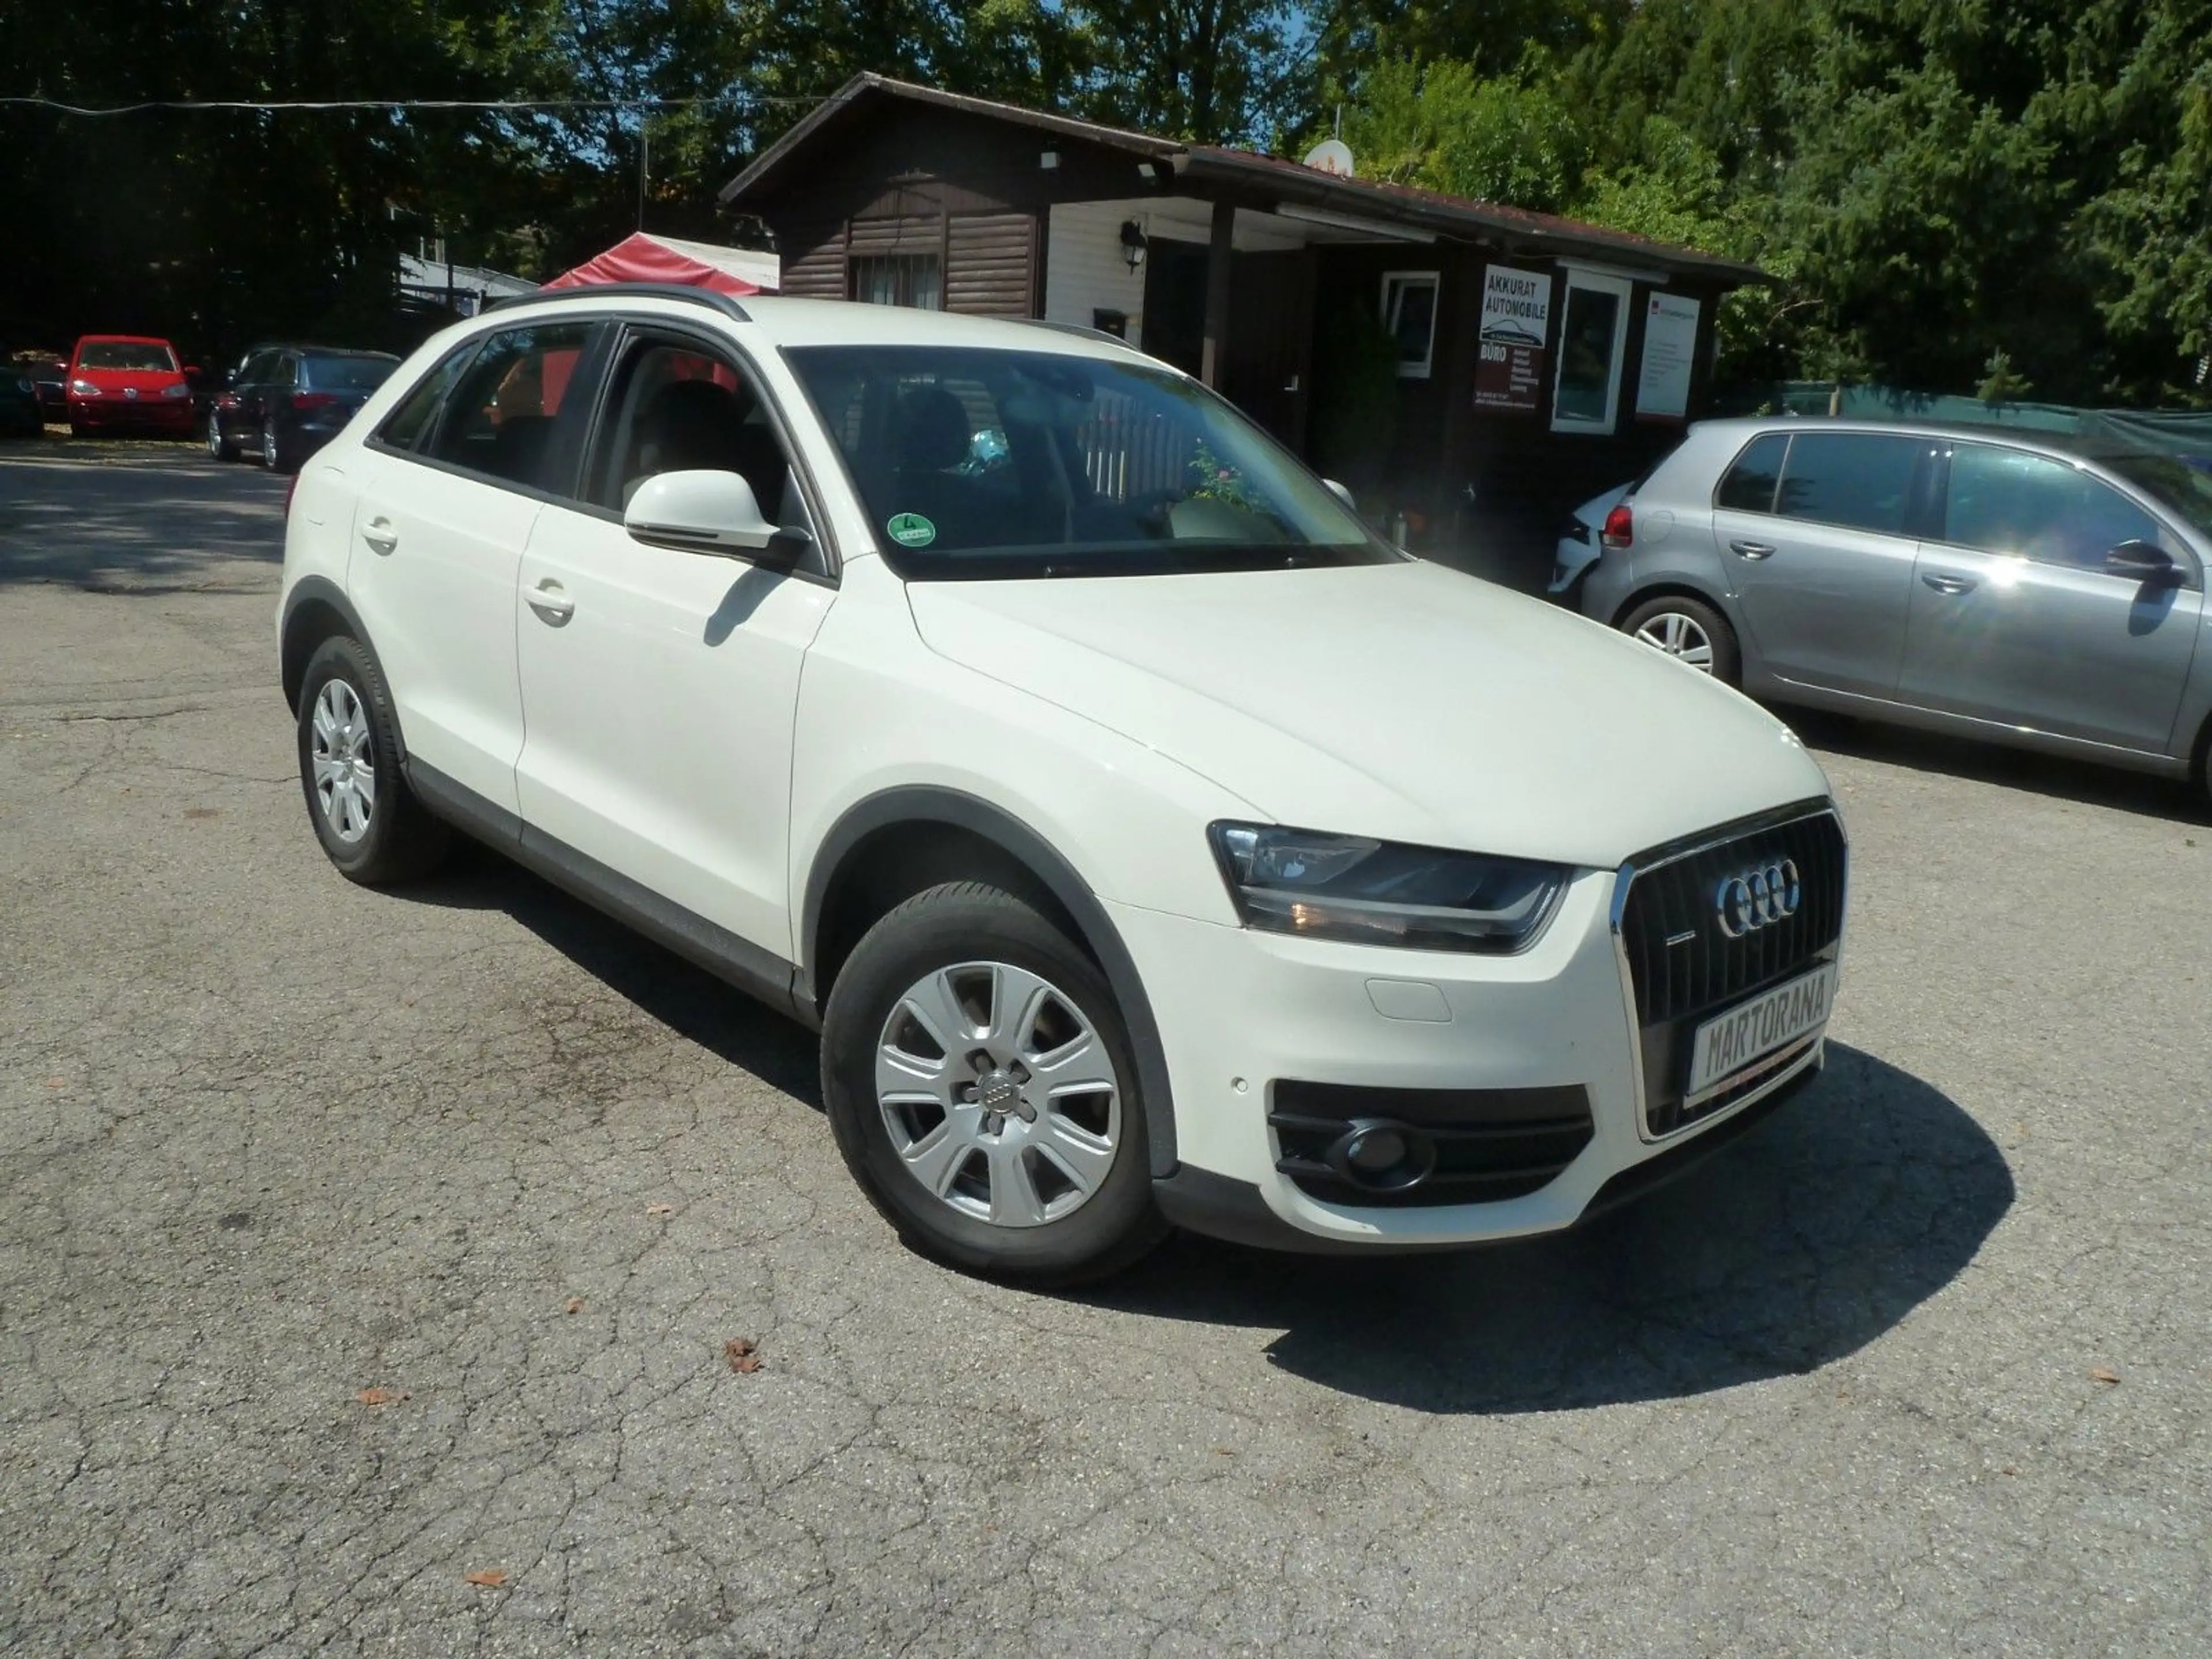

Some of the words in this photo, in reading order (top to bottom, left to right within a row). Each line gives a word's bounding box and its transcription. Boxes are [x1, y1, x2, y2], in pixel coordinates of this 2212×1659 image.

[1488, 275, 1536, 297] AKKURAT
[1486, 295, 1546, 320] AUTOMOBILE
[1481, 343, 1506, 362] BÜRO
[904, 516, 916, 529] 4
[1707, 974, 1826, 1077] MARTORANA
